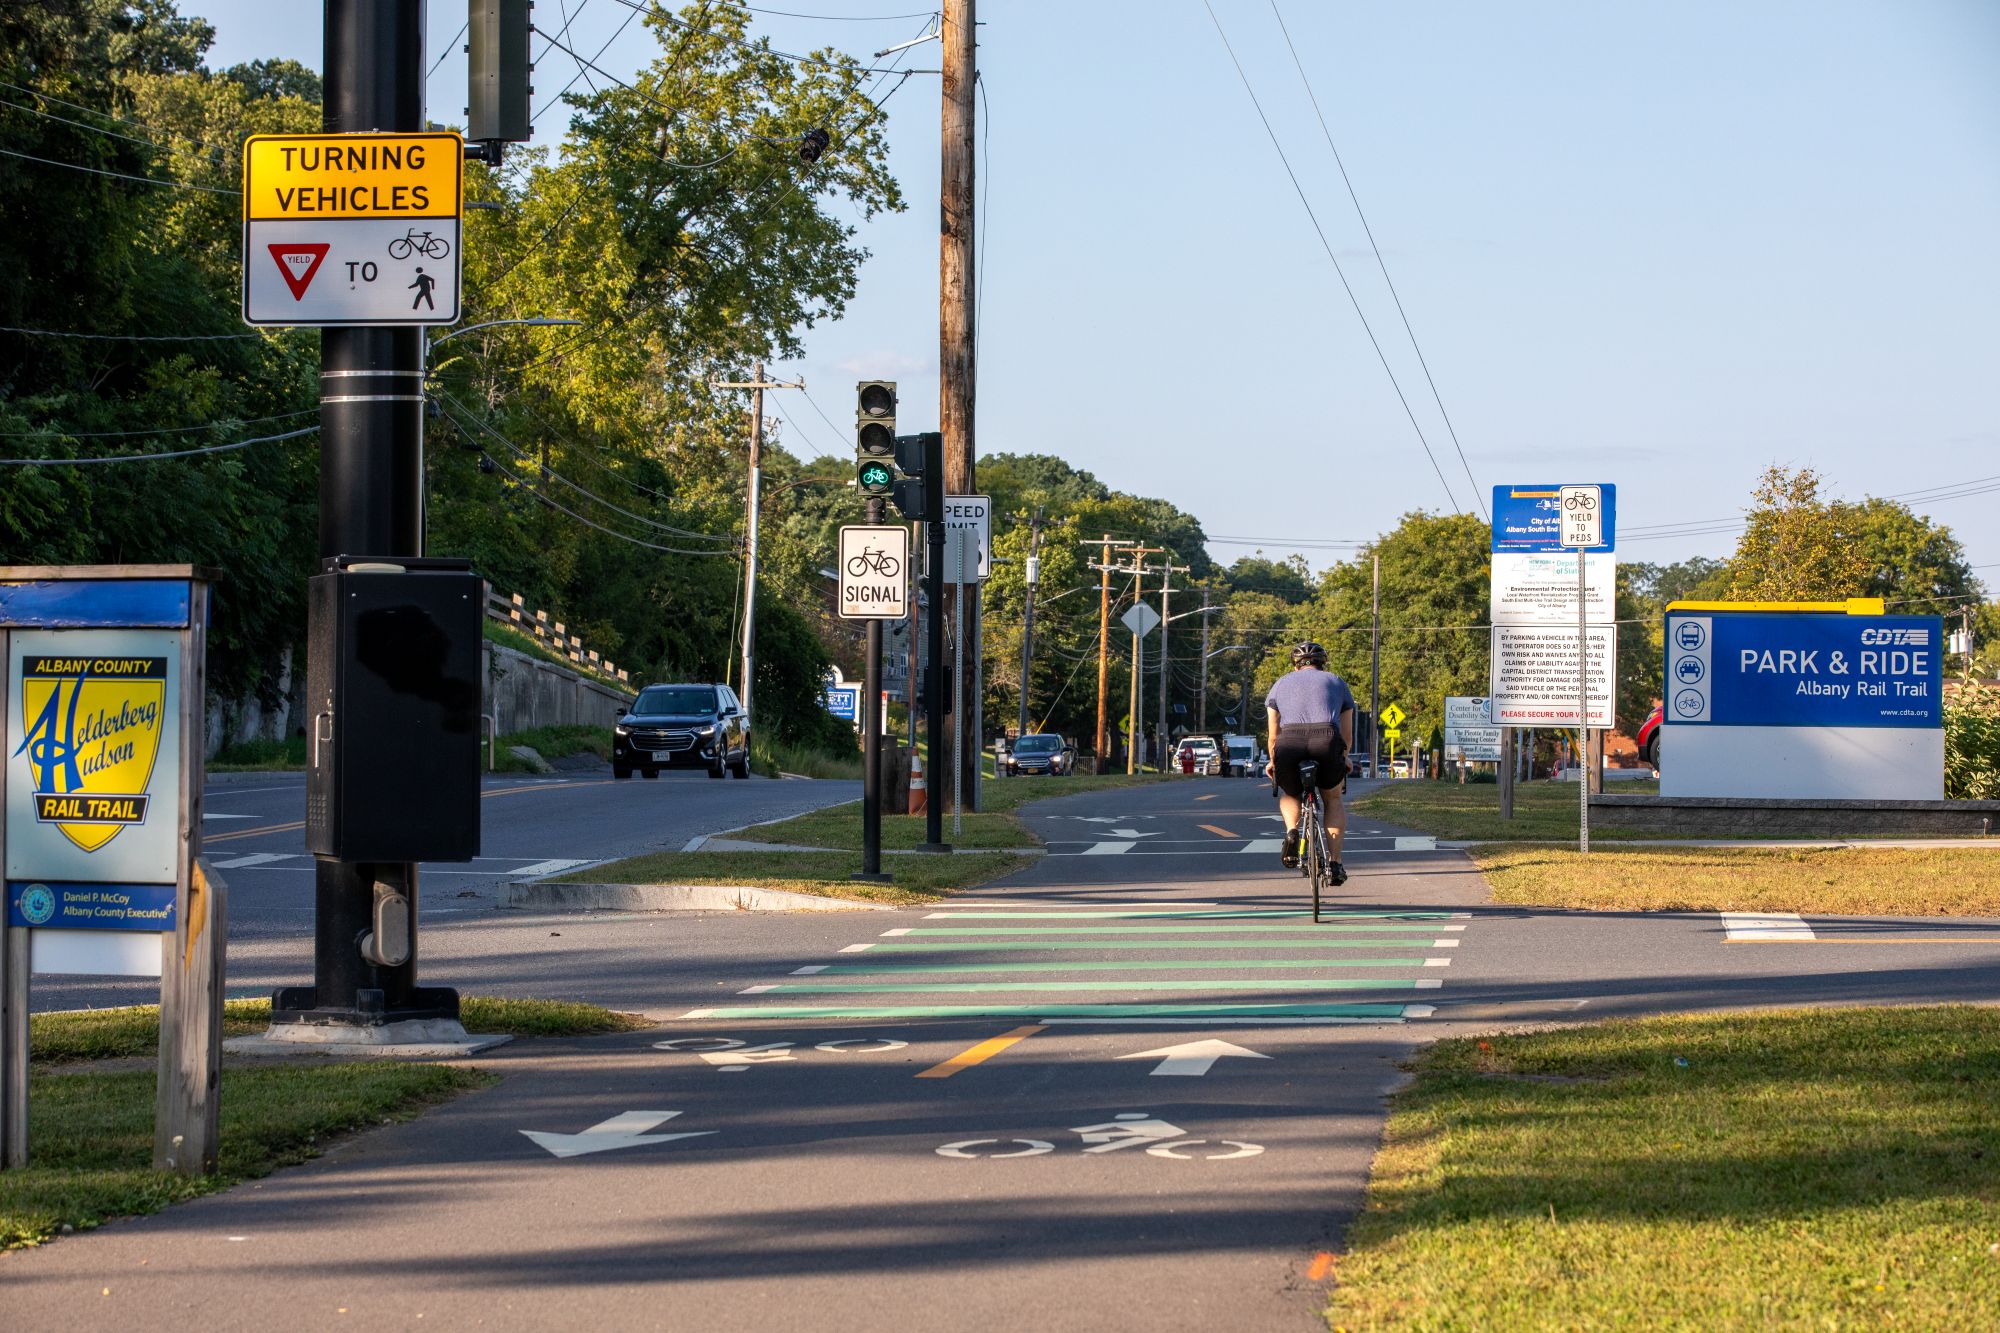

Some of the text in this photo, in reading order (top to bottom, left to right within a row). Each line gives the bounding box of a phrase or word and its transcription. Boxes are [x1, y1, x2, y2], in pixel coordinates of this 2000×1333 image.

[281, 146, 426, 171] TURNING
[276, 186, 429, 211] VEHICLES
[345, 262, 378, 282] TO
[946, 506, 984, 517] PEED
[846, 586, 901, 602] SIGNAL
[1861, 629, 1928, 645] CDTA
[36, 660, 152, 673] ALBANY COUNTY
[1741, 650, 1929, 675] PARK & RIDE
[1796, 681, 1928, 699] Albany Rail Trail
[1880, 709, 1928, 717] www.cdta.org
[43, 799, 138, 818] RAIL TRAIL
[64, 892, 130, 905] Daniel P. McCoy
[63, 906, 168, 919] Albany County Executive
